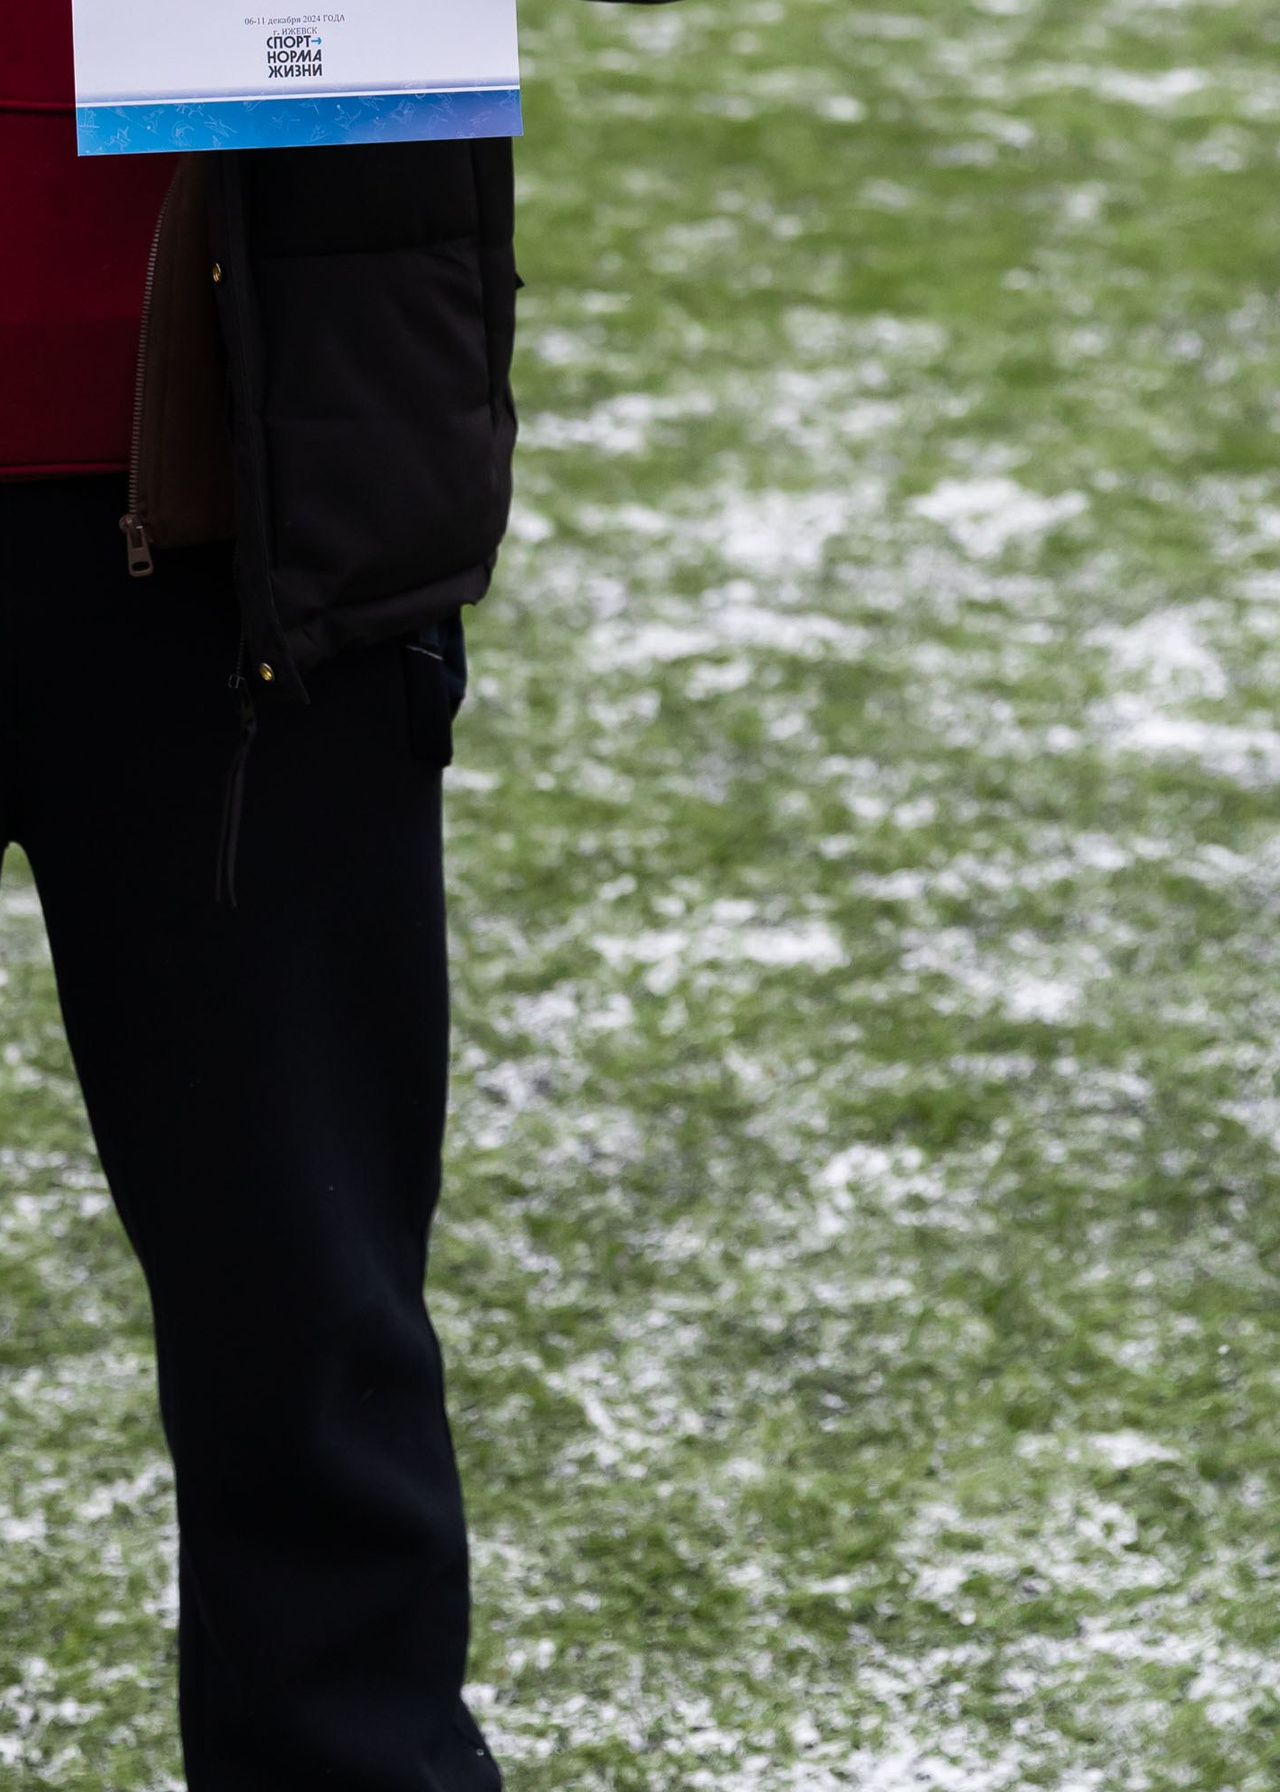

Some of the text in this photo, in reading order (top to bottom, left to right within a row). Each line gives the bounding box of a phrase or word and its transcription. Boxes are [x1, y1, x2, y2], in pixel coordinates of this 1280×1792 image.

[268, 15, 301, 25] декабря
[303, 15, 321, 23] 2024
[323, 14, 345, 23] ГОДА
[282, 27, 317, 35] ИЖЕВСК
[266, 36, 311, 49] СПОРТ
[268, 50, 322, 63] НОРМА
[268, 64, 323, 78] ЖИЗНИ
